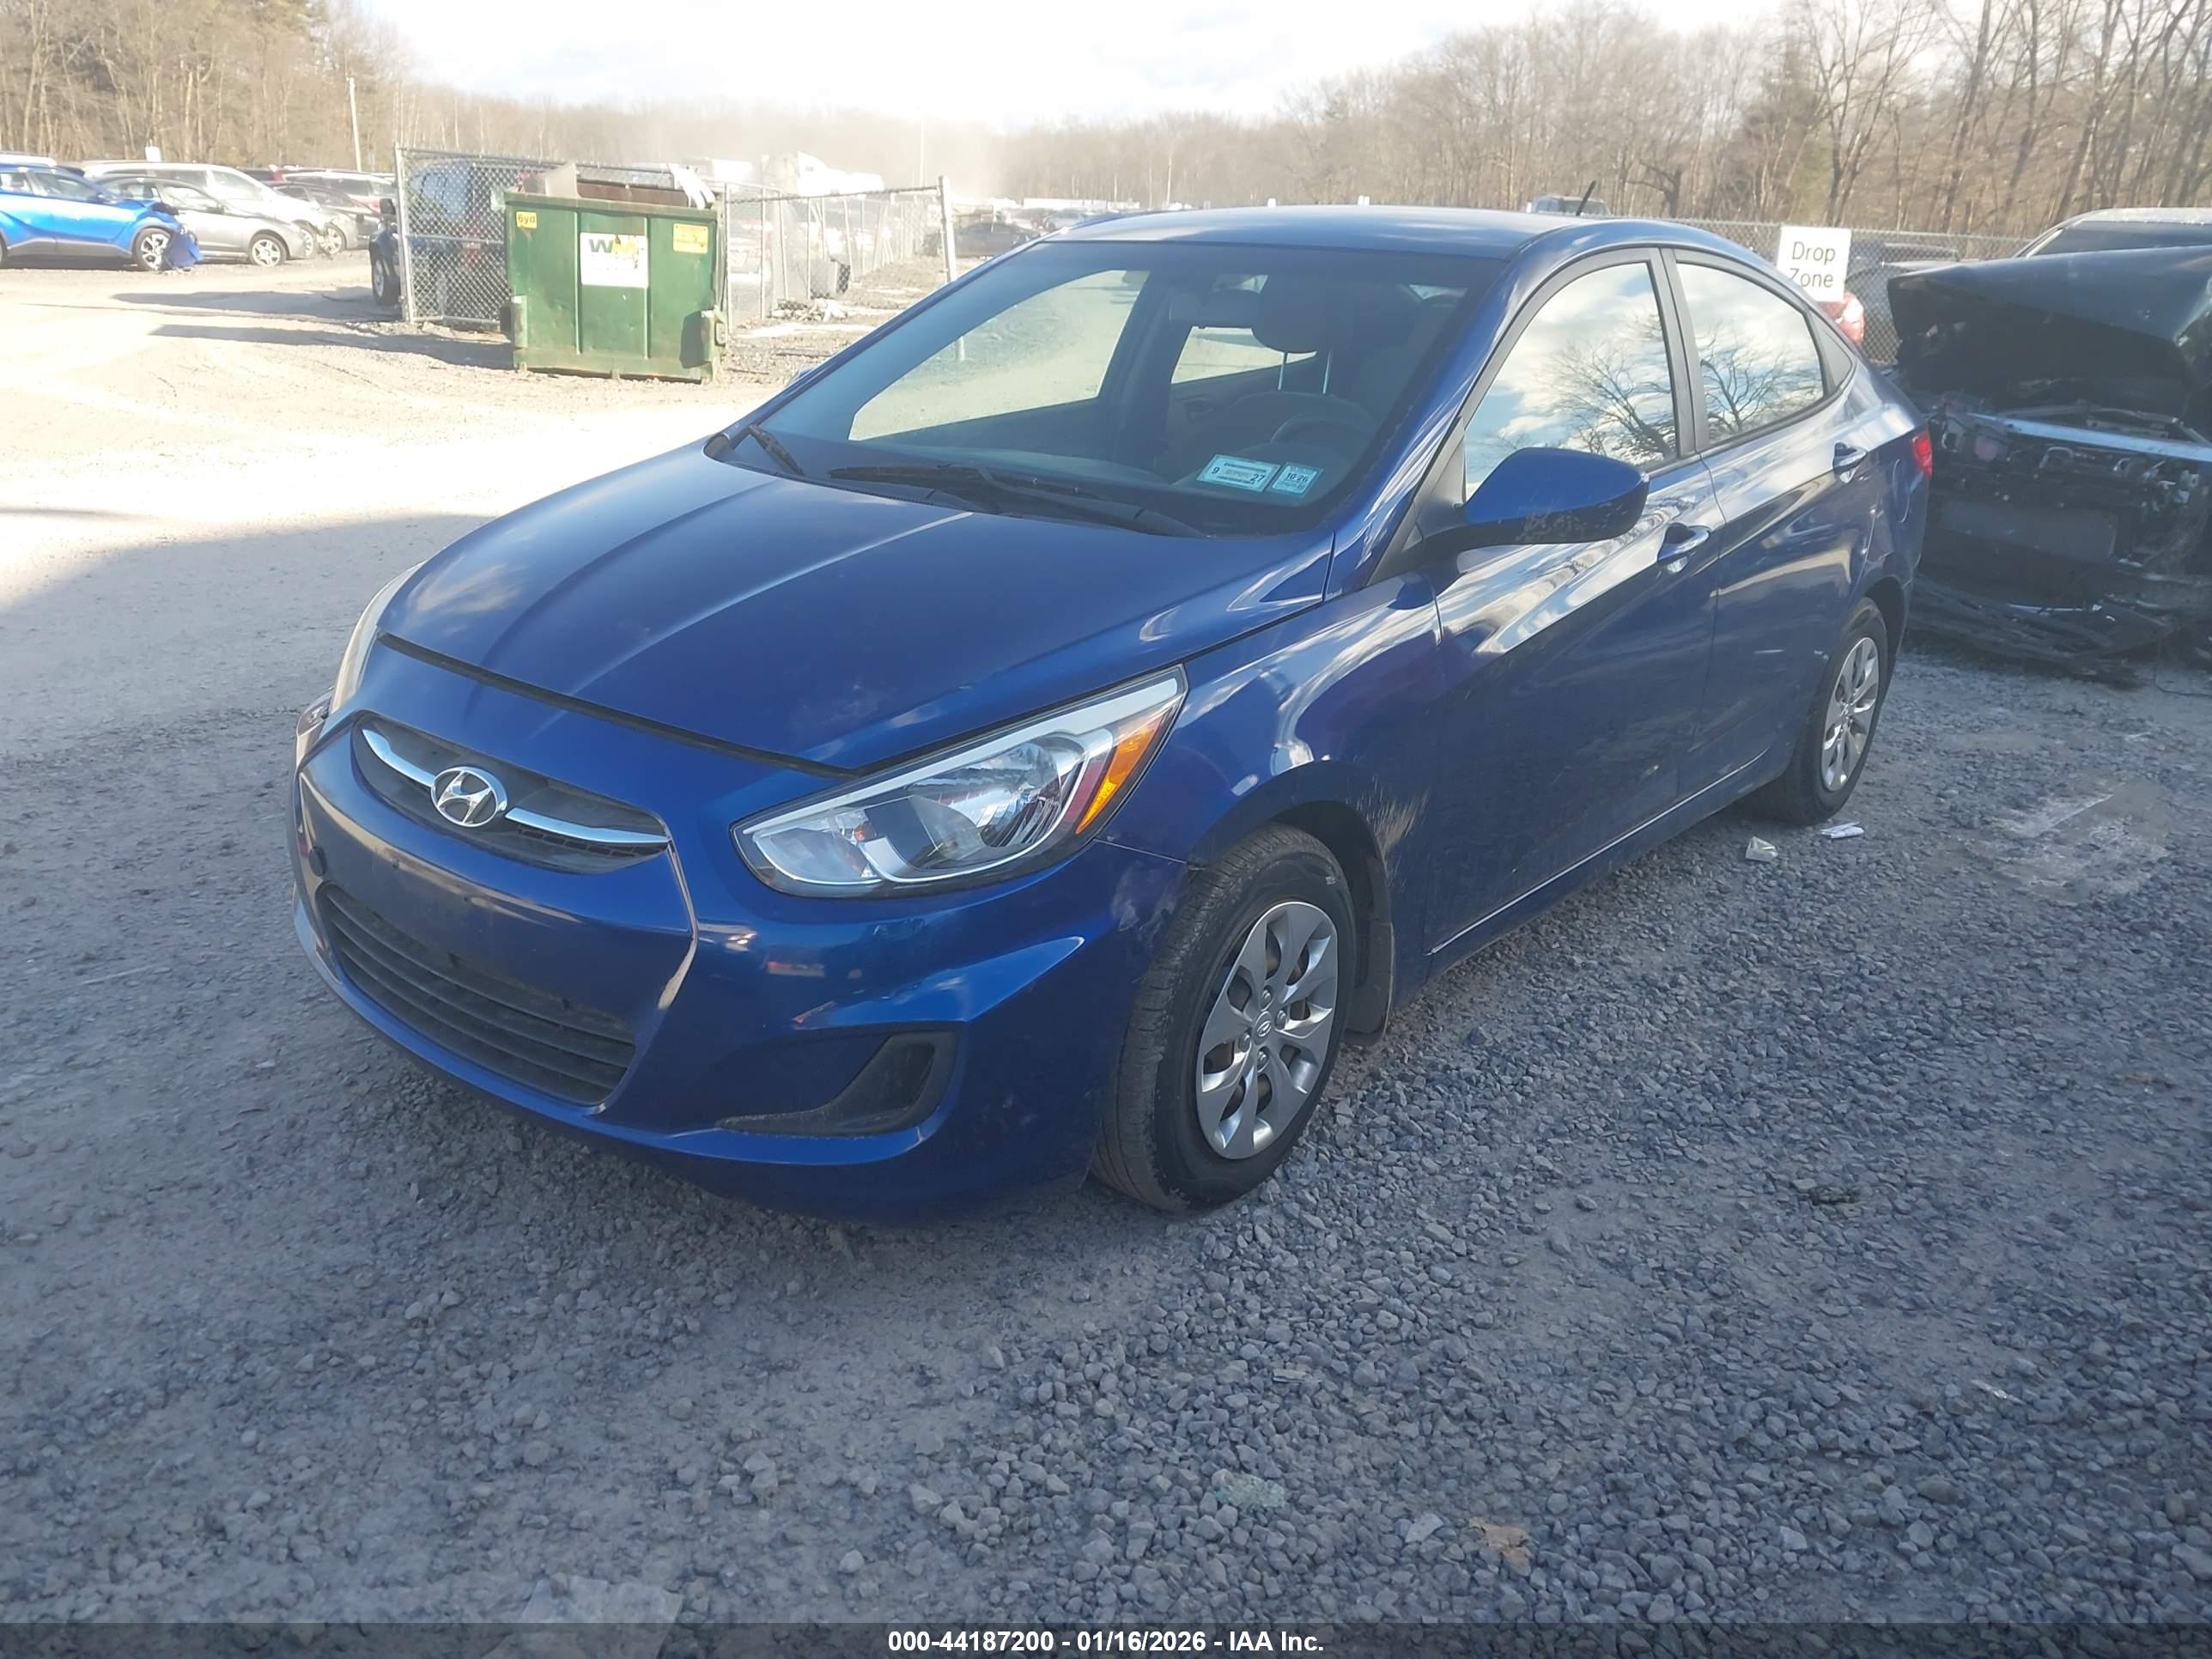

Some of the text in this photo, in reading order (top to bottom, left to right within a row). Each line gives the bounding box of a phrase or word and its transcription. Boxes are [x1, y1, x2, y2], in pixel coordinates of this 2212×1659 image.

[518, 213, 536, 225] 6yd
[1792, 241, 1836, 265] Drop
[1249, 473, 1267, 483] 27
